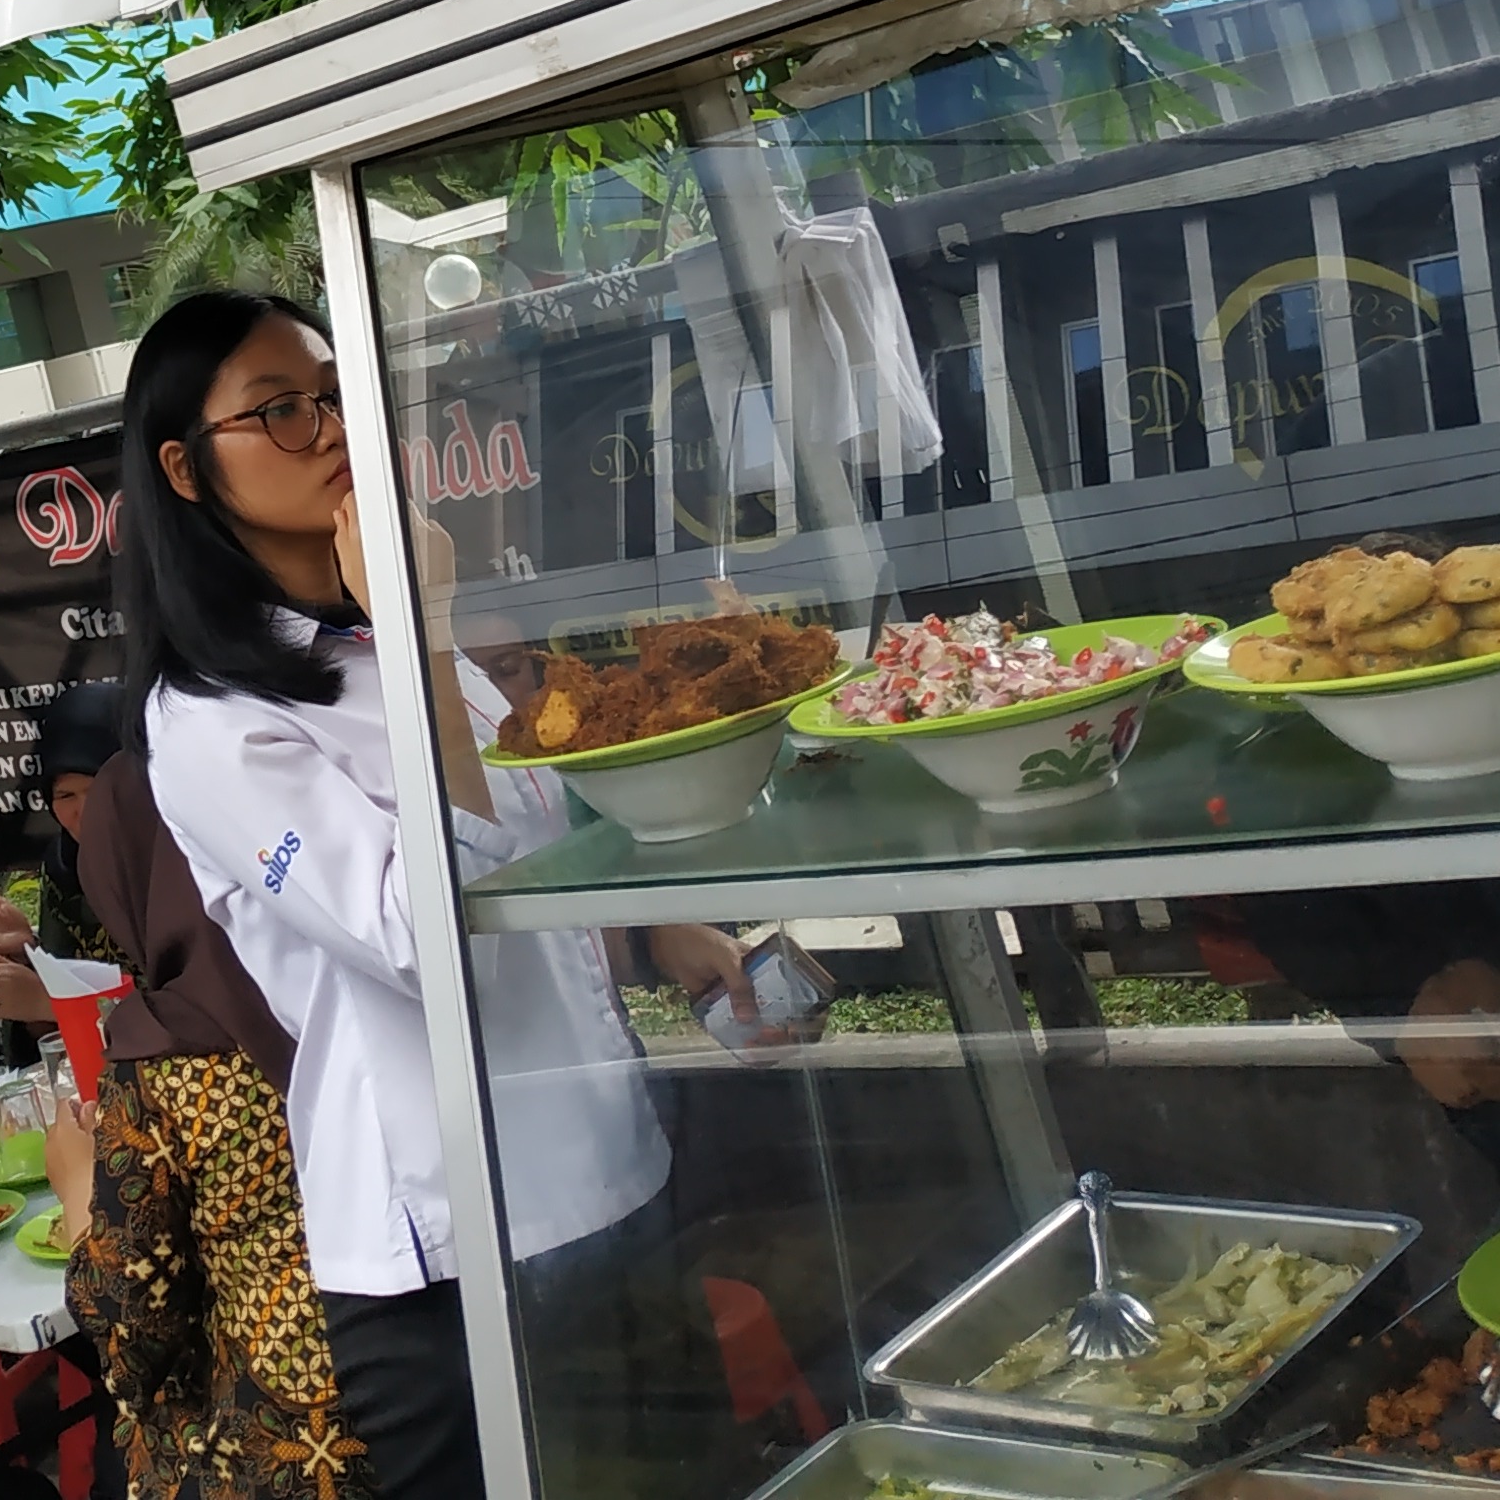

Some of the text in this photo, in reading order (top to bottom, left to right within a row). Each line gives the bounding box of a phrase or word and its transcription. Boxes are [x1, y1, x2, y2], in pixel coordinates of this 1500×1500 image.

[61, 605, 127, 640] Cita
[14, 719, 47, 743] EM
[27, 789, 49, 811] G
